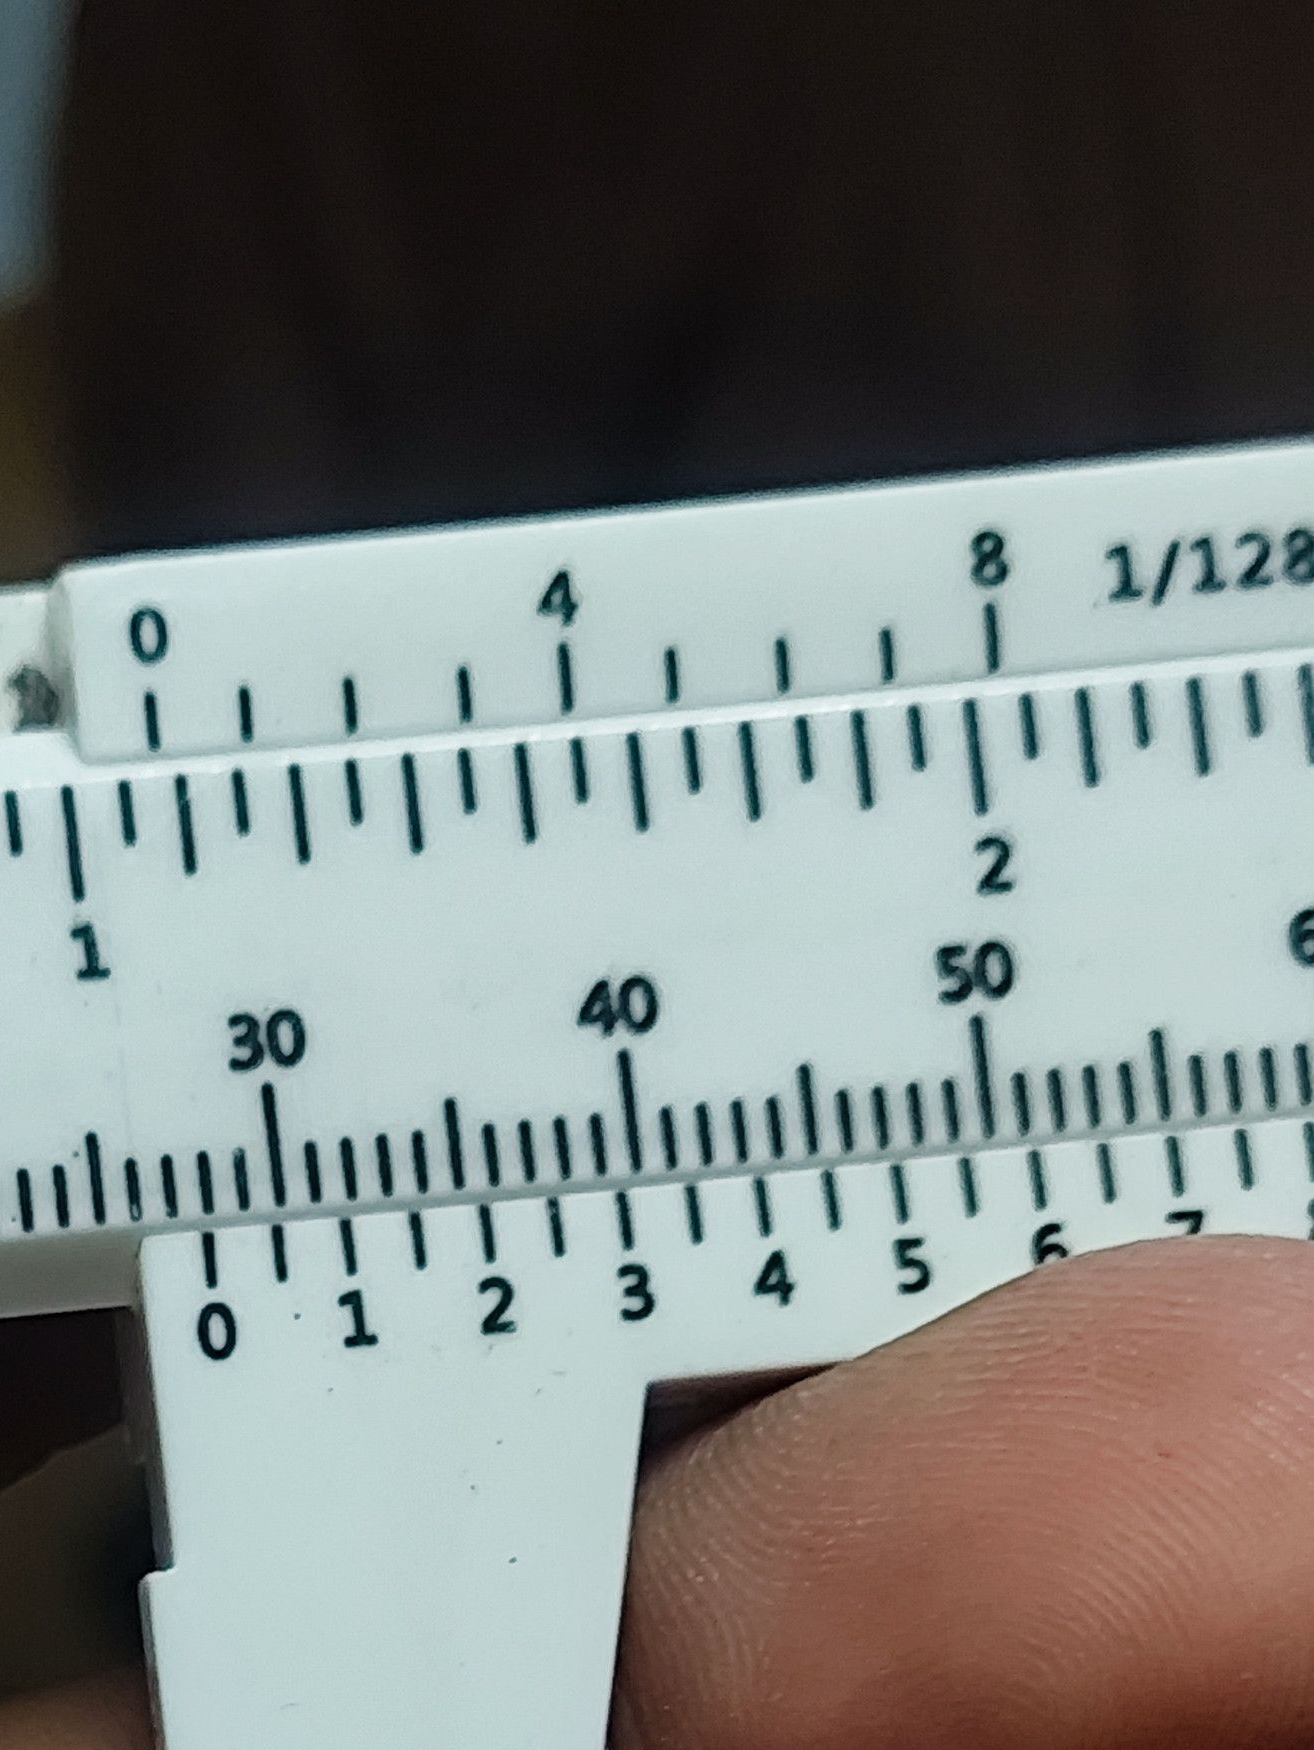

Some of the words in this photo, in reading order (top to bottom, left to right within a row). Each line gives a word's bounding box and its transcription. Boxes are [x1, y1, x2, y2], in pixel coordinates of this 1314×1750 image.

[128, 606, 169, 665] 0
[536, 569, 580, 628] 4
[969, 529, 1011, 588] 8
[1105, 527, 1314, 606] 1/128
[68, 920, 112, 983] 1
[974, 836, 1014, 896] 2
[226, 1007, 307, 1073] 30
[576, 973, 661, 1038] 40
[935, 939, 1016, 1005] 50
[195, 1301, 238, 1362] 0
[336, 1288, 380, 1350] 1
[477, 1275, 517, 1337] 2
[616, 1262, 657, 1323] 3
[752, 1248, 796, 1307] 4
[893, 1236, 932, 1296] 5
